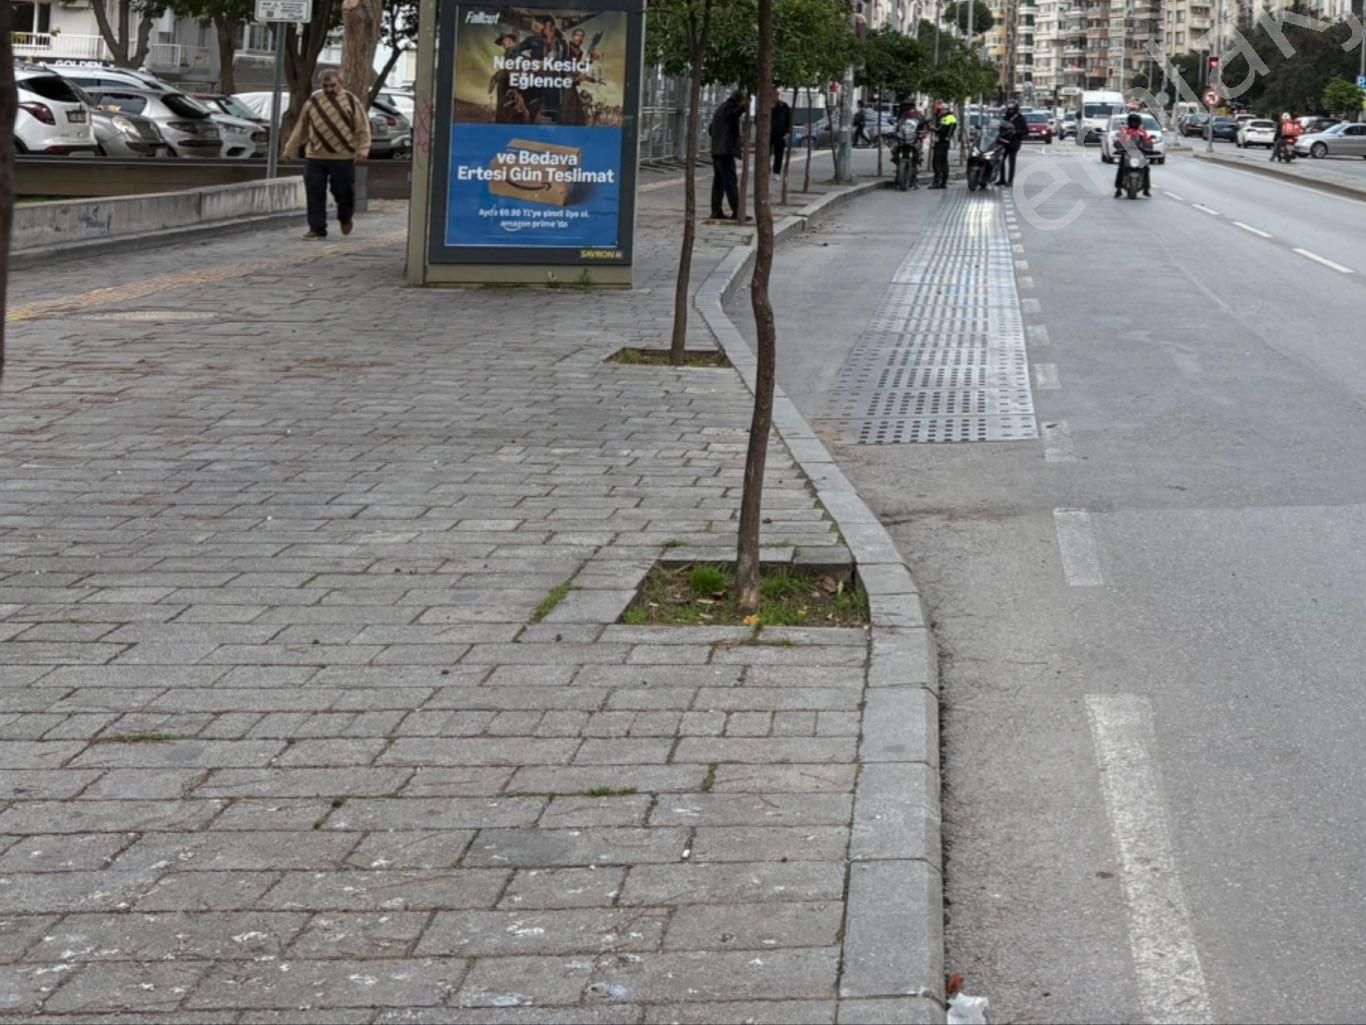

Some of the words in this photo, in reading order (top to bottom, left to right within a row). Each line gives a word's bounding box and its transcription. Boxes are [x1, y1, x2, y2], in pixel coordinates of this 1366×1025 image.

[465, 11, 500, 24] Fallout
[493, 56, 540, 71] Nefes
[543, 57, 591, 72] Kesici
[509, 72, 574, 89] Eğlence
[497, 152, 515, 164] ve
[519, 150, 578, 165] Bedava
[457, 165, 506, 181] Ertesi
[510, 166, 542, 182] Gün
[545, 167, 615, 183] Teslimat
[500, 220, 531, 230] amazon
